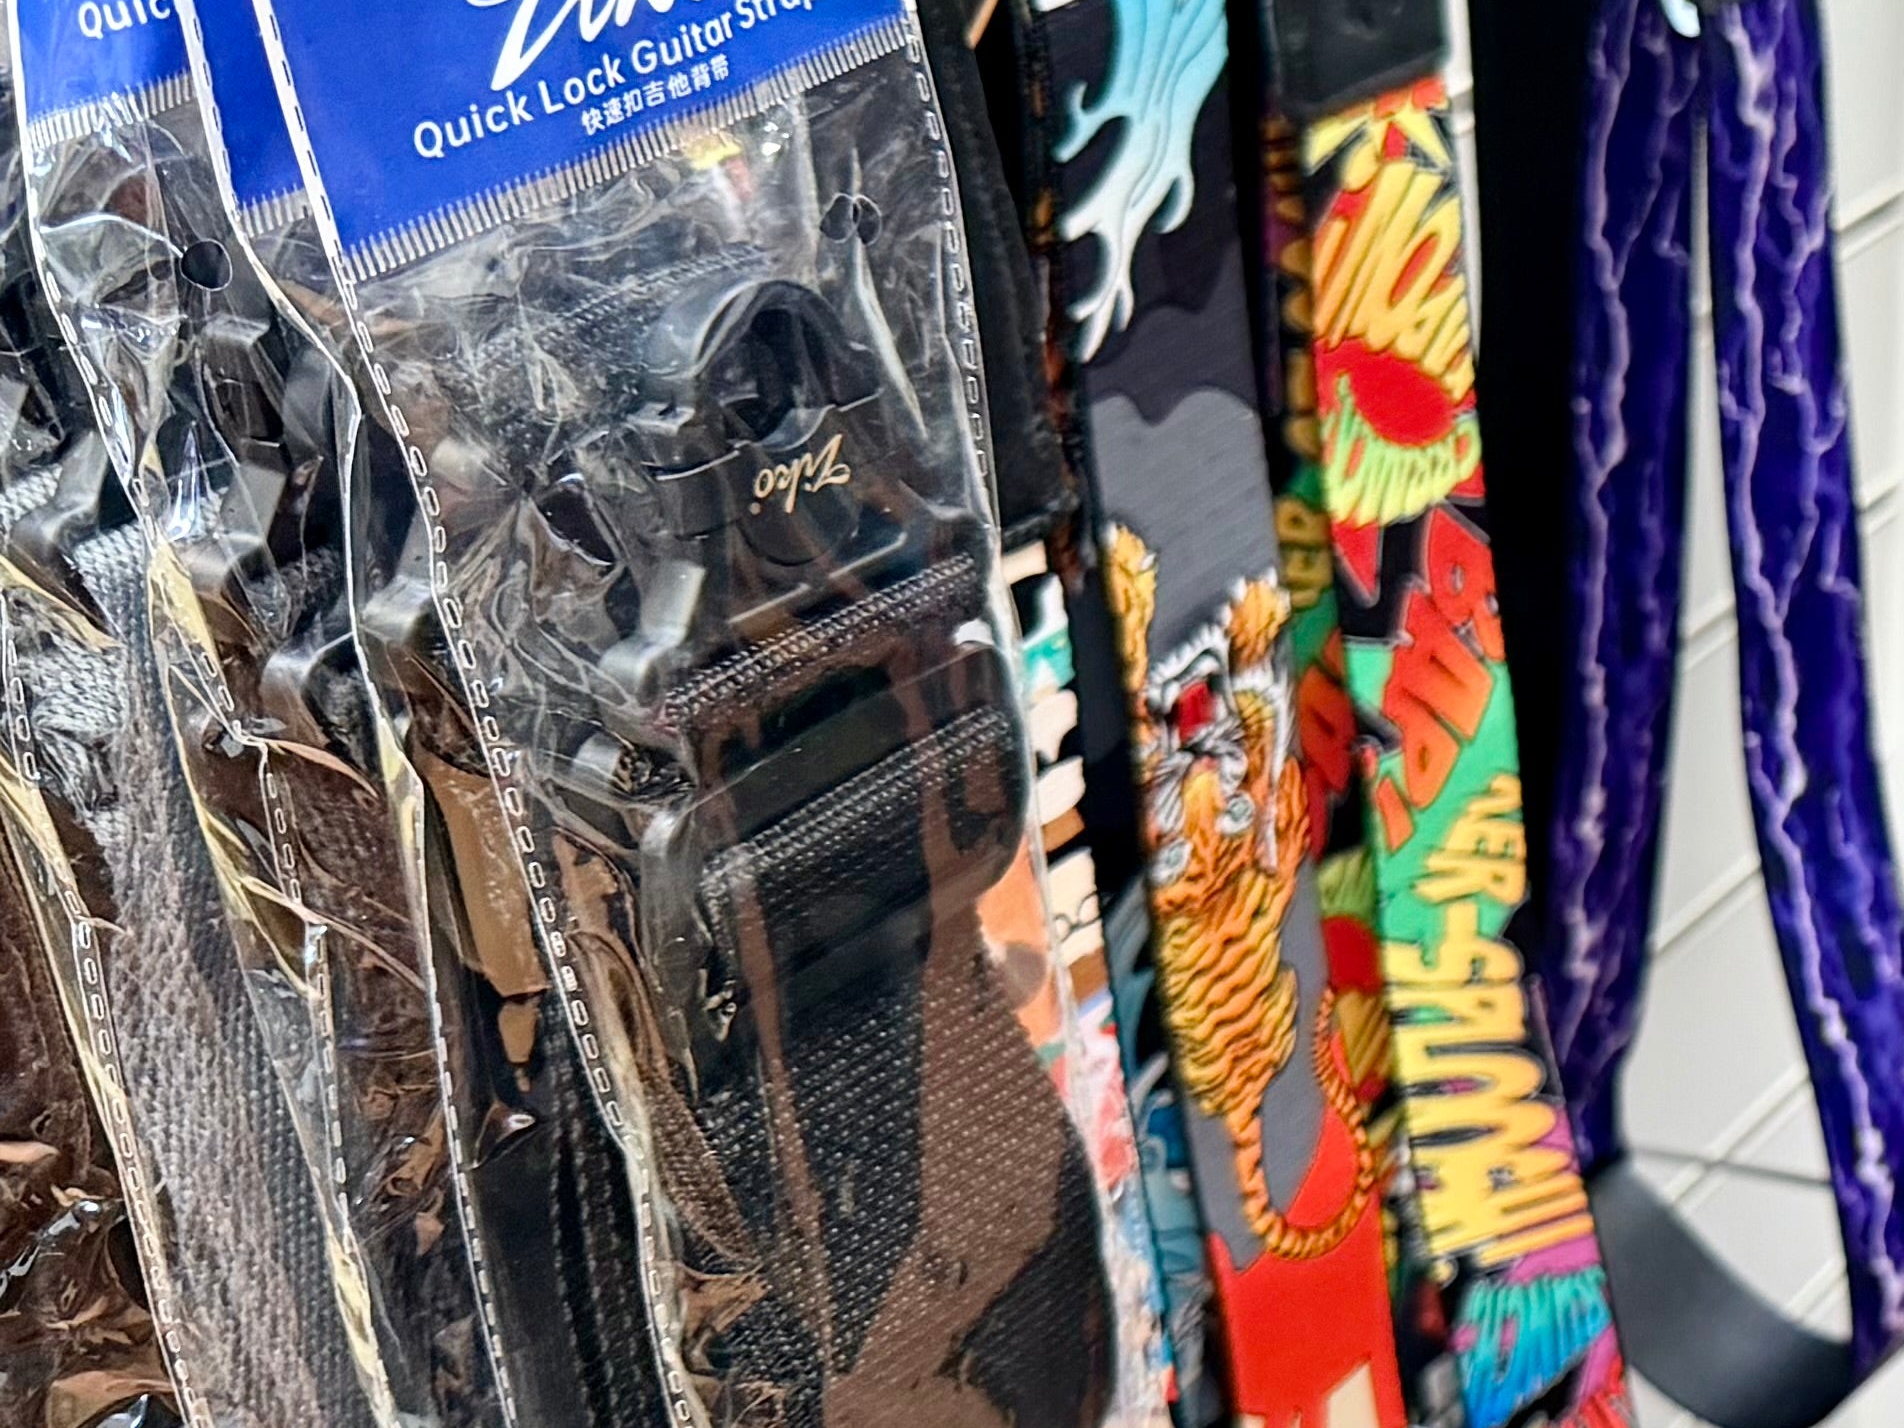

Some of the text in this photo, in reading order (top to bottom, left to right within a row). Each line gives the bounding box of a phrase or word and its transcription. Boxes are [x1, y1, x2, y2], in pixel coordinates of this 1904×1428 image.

[413, 91, 533, 159] Quick
[539, 53, 625, 114] Lock
[631, 12, 734, 74] Guitar
